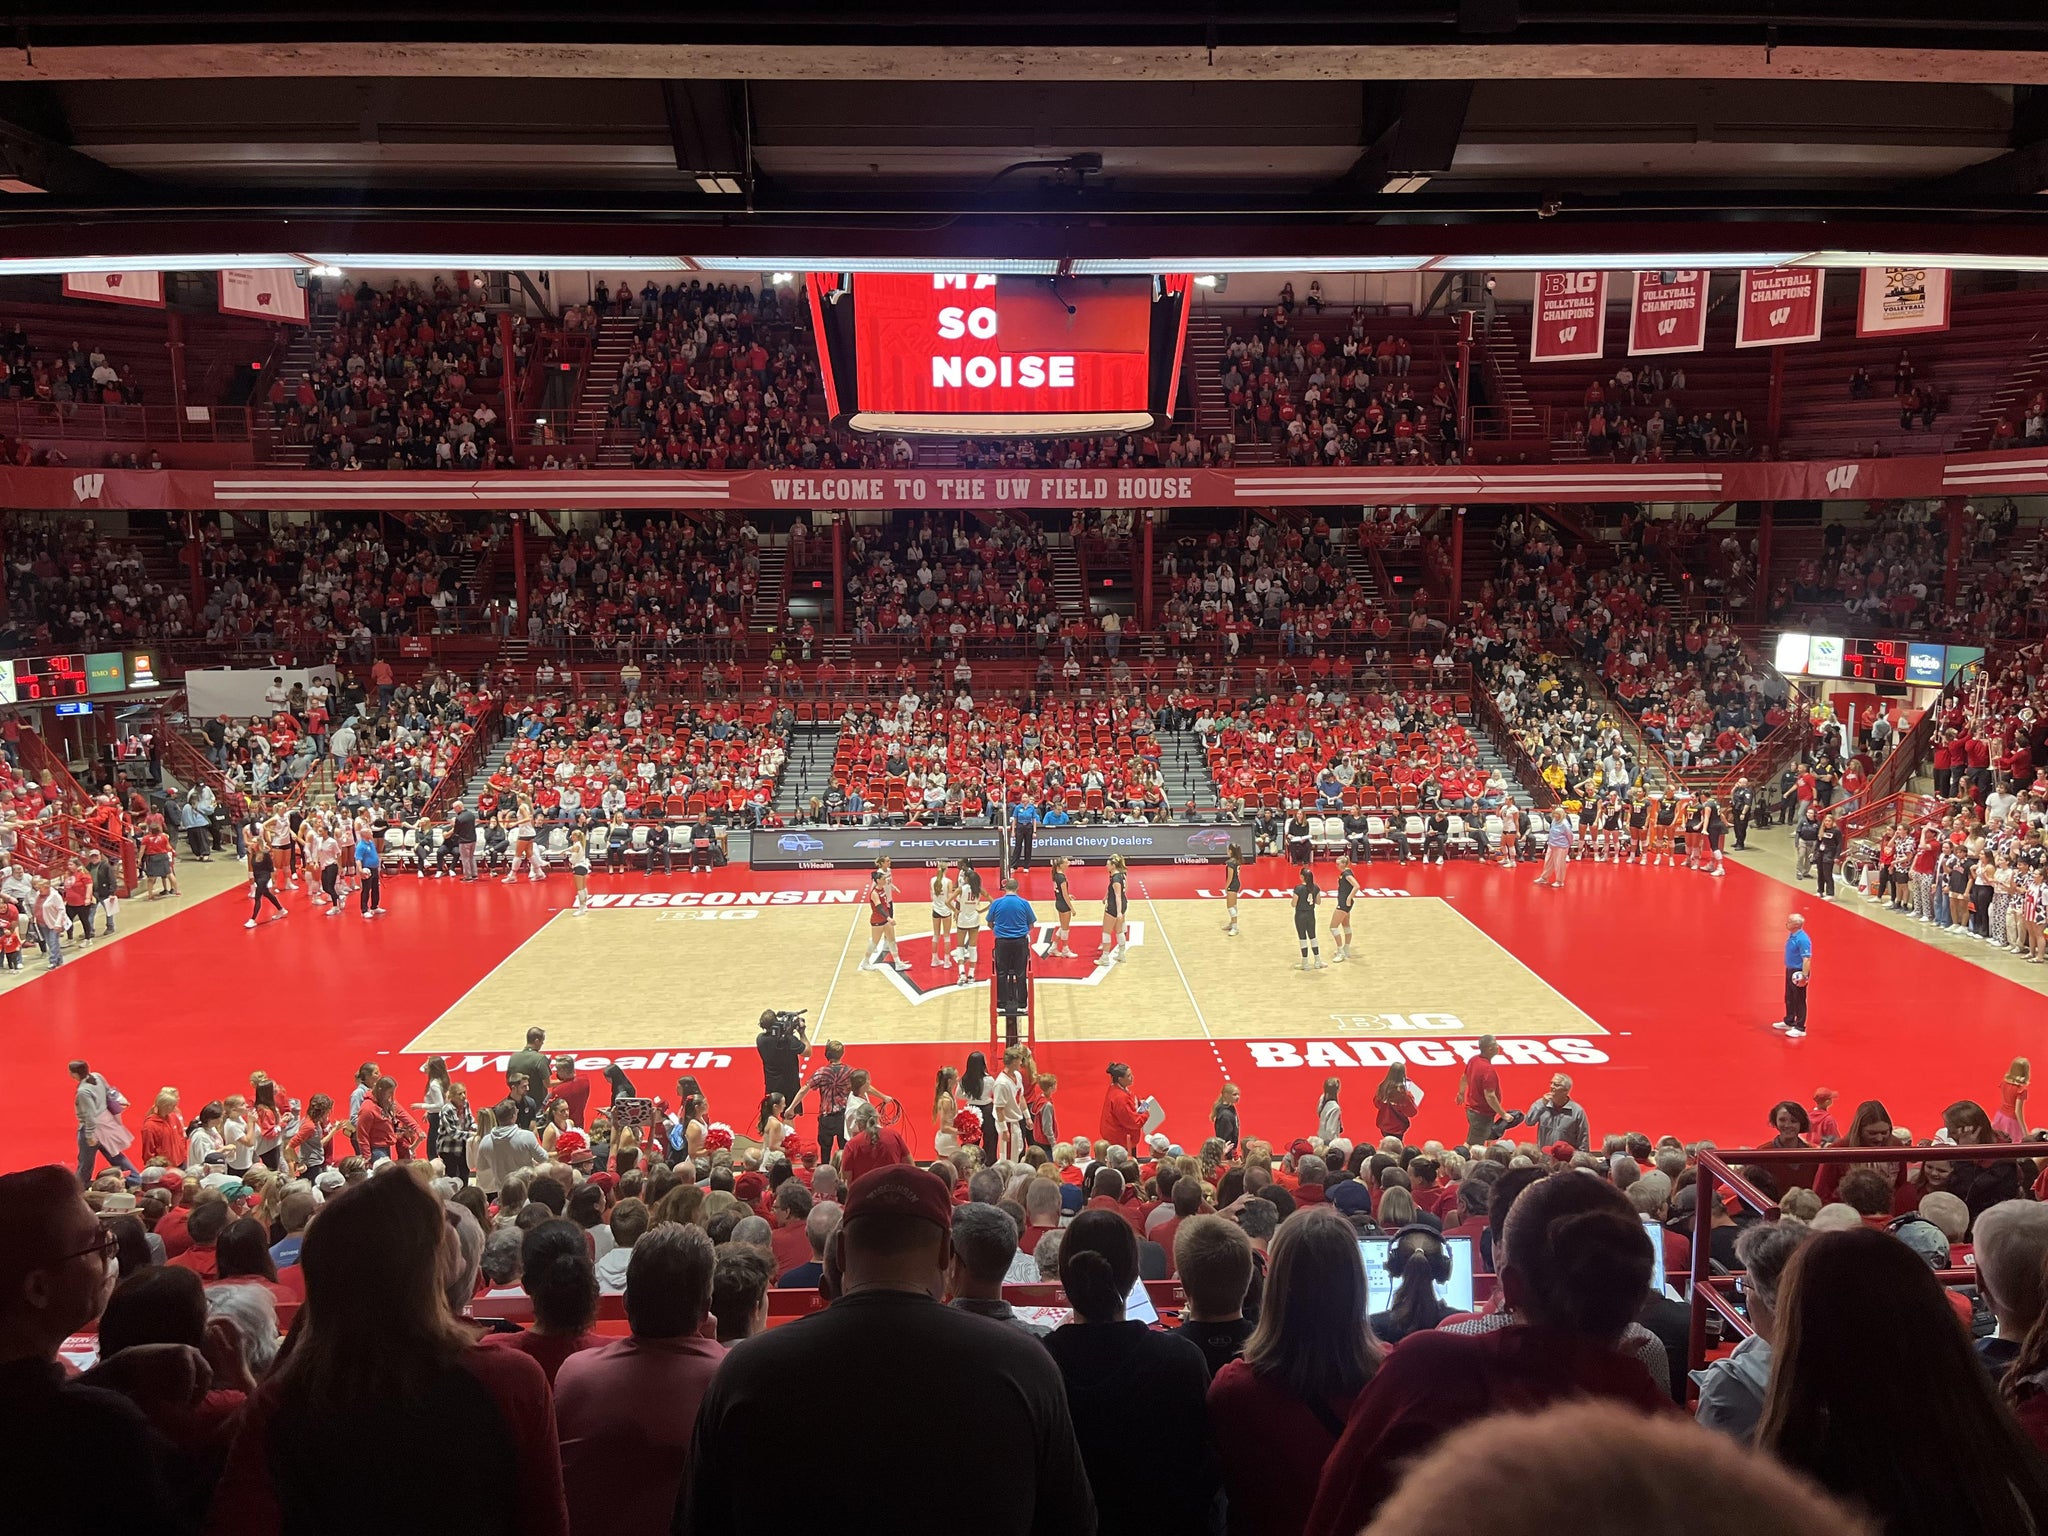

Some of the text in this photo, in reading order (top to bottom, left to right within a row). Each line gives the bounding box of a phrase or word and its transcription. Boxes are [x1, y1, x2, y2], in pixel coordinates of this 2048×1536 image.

[1752, 274, 1811, 290] VOLLEYBALL
[1642, 287, 1696, 300] VOLLEYBALL
[1751, 286, 1811, 302] CHAMPIONS
[1544, 297, 1594, 310] VOLLEYBALL
[1641, 298, 1695, 313] CHAMPIONS
[1543, 308, 1594, 321] CHAMPIONS
[932, 356, 1075, 388] NOISE
[1826, 465, 1859, 492] W
[73, 474, 105, 502] W
[771, 477, 1191, 500] WELCOME TO THE UW FIELD HOUSE
[900, 839, 999, 847] CHEVROLET
[1075, 837, 1109, 848] Chevy
[1110, 836, 1153, 846] Dealers
[573, 890, 859, 907] WISCONSIN
[1307, 893, 1313, 905] 4
